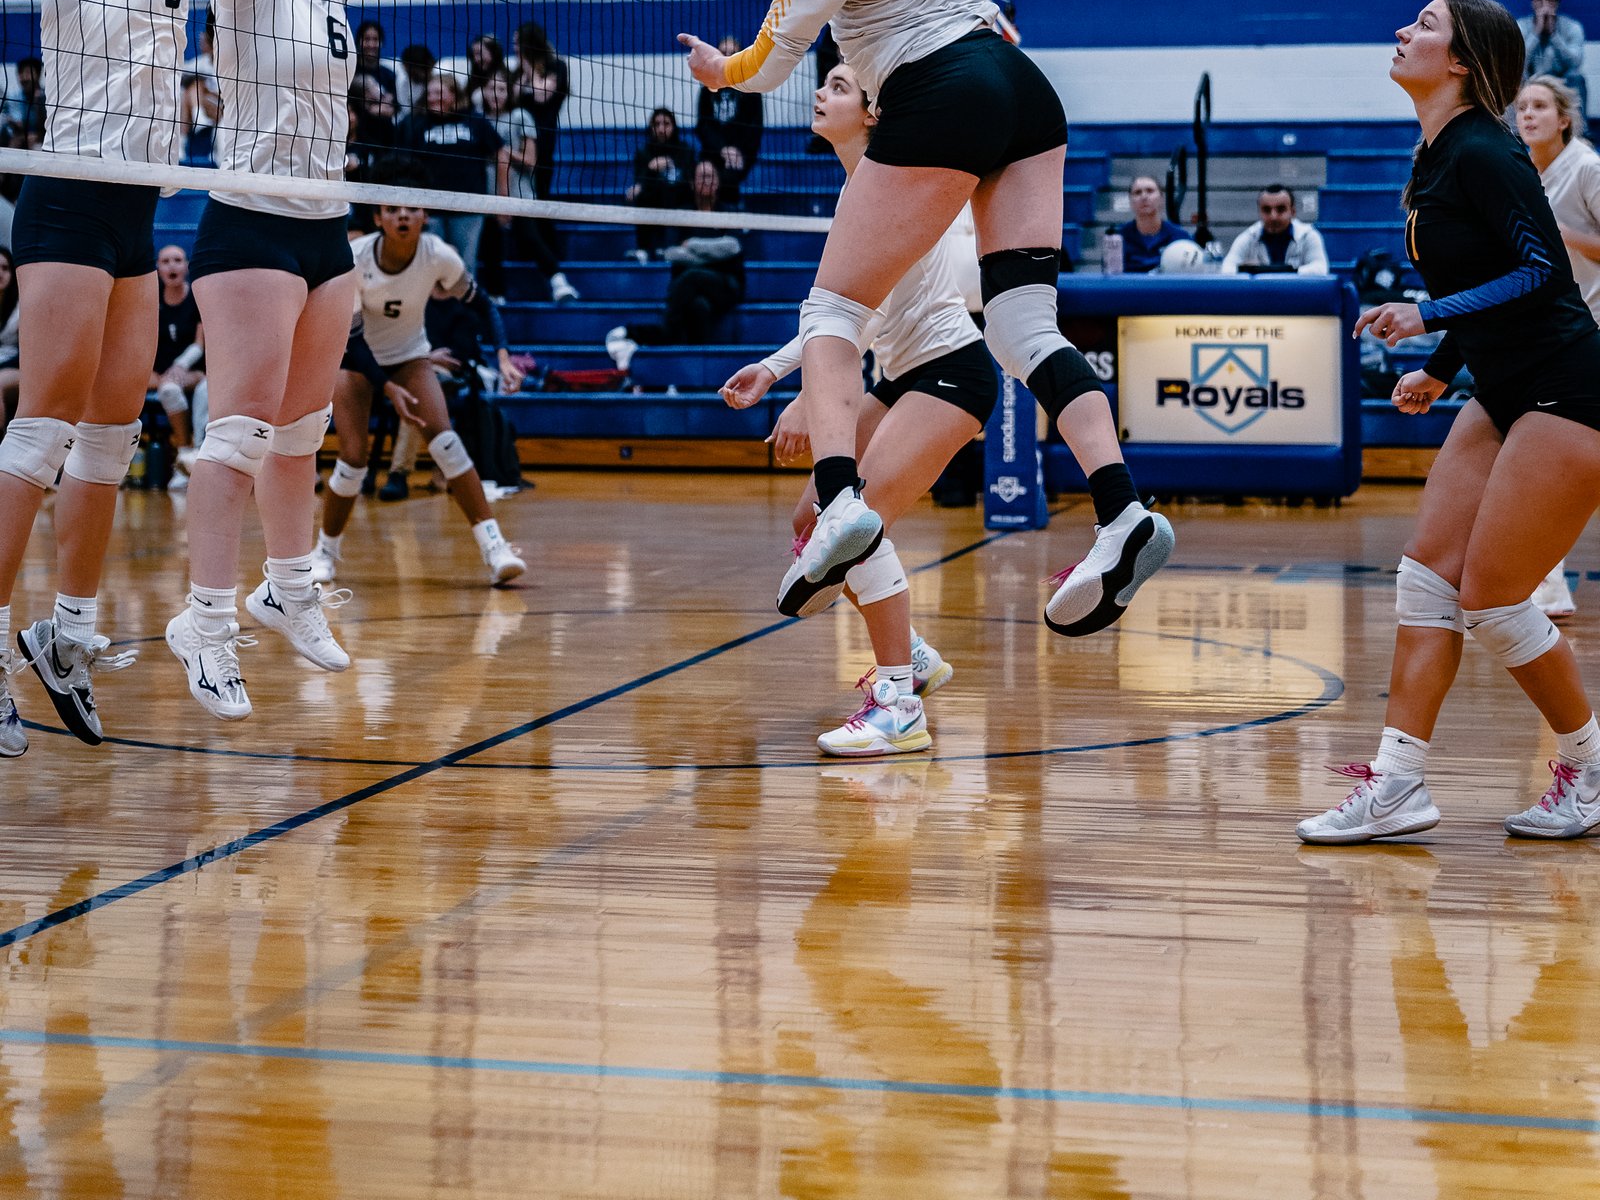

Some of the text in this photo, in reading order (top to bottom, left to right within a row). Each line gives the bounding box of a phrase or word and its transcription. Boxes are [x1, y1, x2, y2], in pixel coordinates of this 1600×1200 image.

[326, 15, 350, 61] 6
[384, 299, 403, 320] 5
[1175, 326, 1285, 340] HOME OF THE
[1156, 378, 1306, 417] Royals
